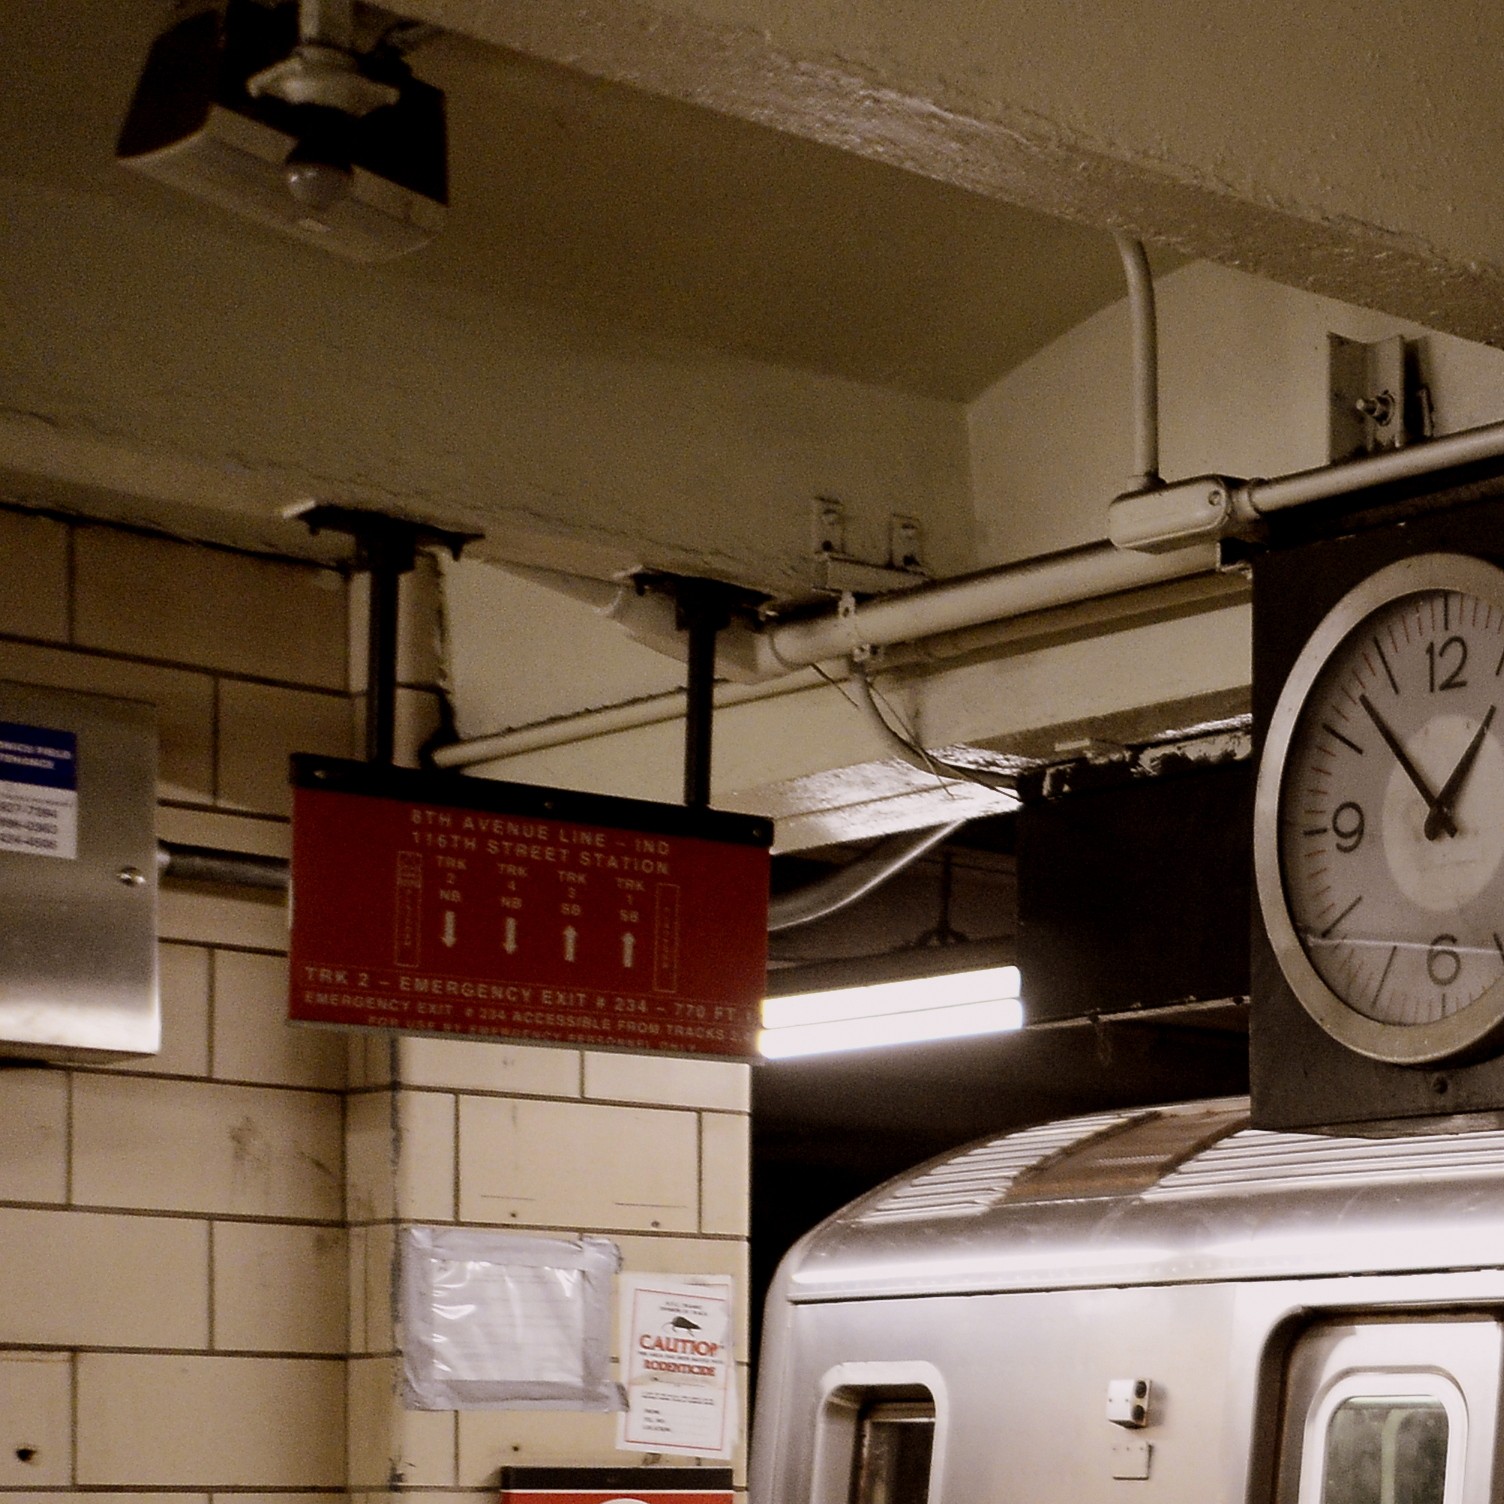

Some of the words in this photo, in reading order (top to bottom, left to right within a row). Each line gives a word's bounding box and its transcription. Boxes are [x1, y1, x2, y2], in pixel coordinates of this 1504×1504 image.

[1425, 636, 1468, 693] 12
[462, 815, 549, 841] AVENUE
[559, 828, 606, 848] LINE
[1332, 801, 1365, 853] 9
[411, 831, 477, 852] 116TH
[486, 839, 570, 862] STREET
[579, 851, 671, 876] STATION
[435, 855, 467, 871] TRK
[446, 873, 457, 885] 2
[497, 863, 528, 878] TRK
[507, 880, 517, 891] 4
[557, 870, 588, 885] TRK
[616, 877, 646, 892] TRK
[1426, 933, 1460, 985] 6
[305, 966, 348, 985] TRK
[357, 972, 370, 987] 2
[400, 975, 533, 1004] EMERGENCY
[542, 989, 588, 1007] EXIT
[614, 997, 648, 1013] 234
[304, 990, 411, 1012] EMERGENCY
[417, 1001, 454, 1015] EXIT
[512, 1010, 612, 1031] ACCESSIBLE
[618, 1020, 661, 1036] FROM
[667, 1024, 726, 1041] TRACKS
